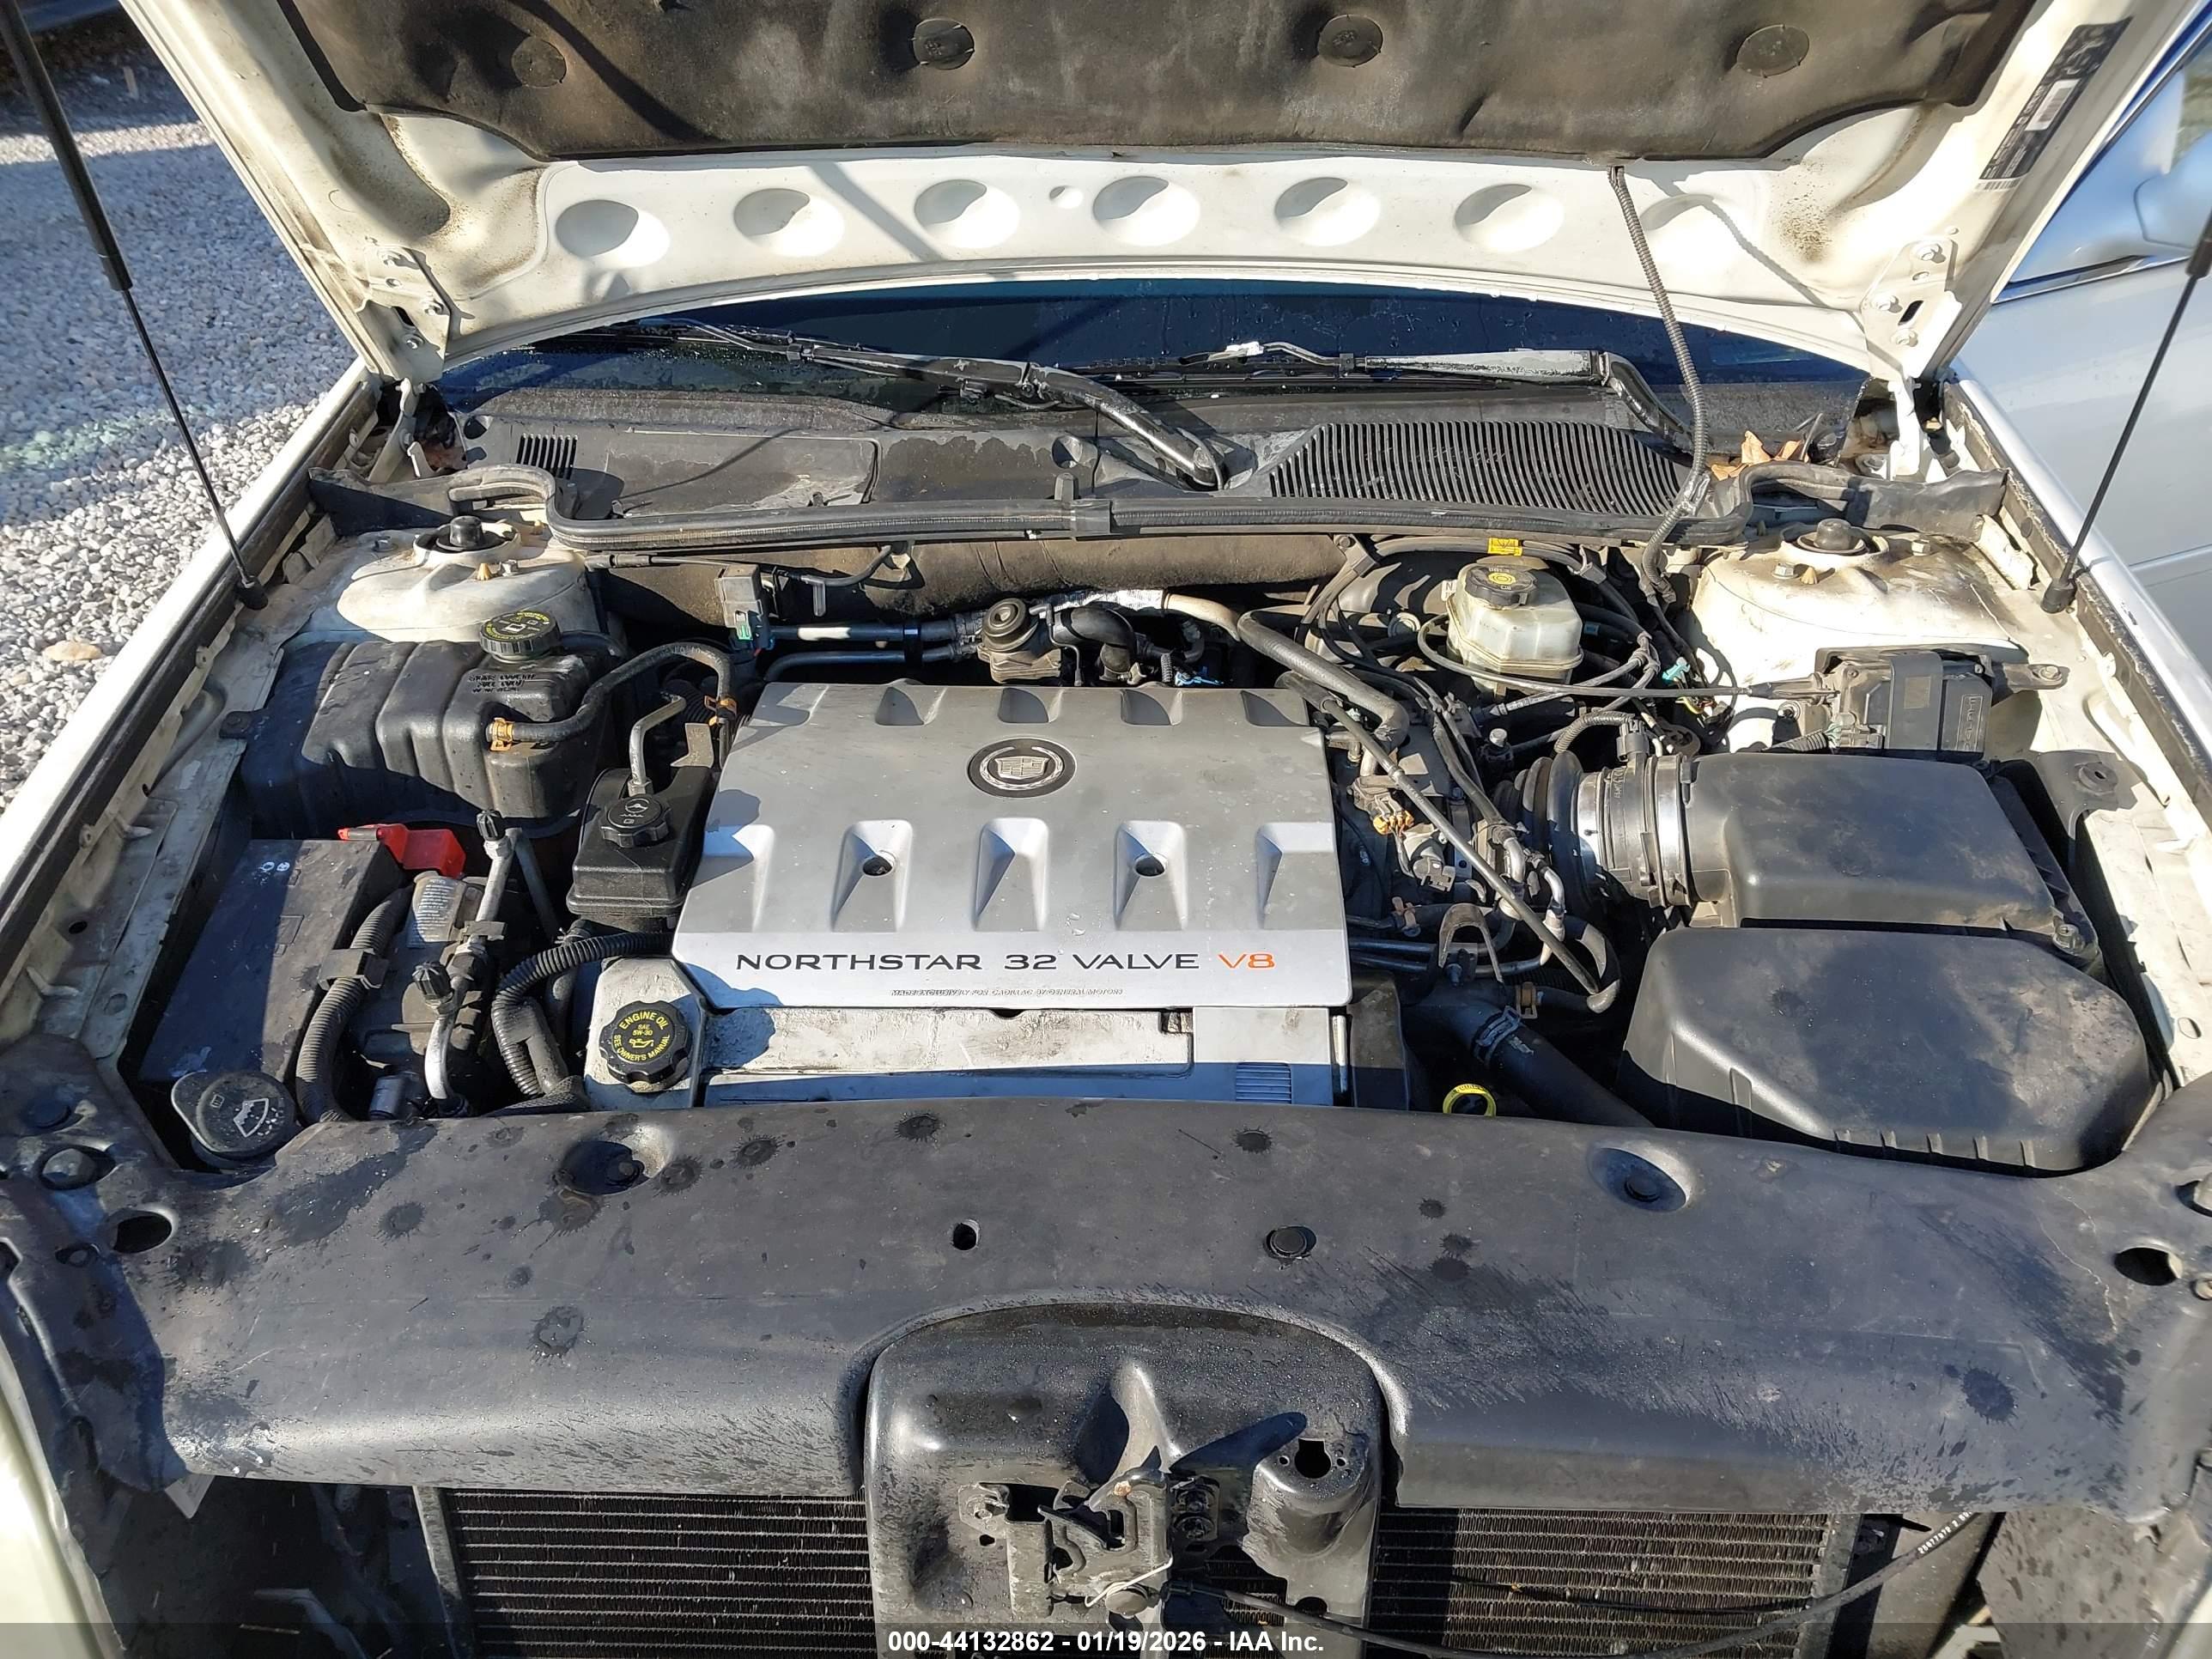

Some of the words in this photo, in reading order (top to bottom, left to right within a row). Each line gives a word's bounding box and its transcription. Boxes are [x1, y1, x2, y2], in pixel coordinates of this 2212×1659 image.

[737, 953, 983, 970] NORTHSTAR
[1004, 954, 1057, 970] 32
[1073, 953, 1200, 969] VALVE
[1218, 953, 1276, 969] V8
[619, 1011, 658, 1030] ENGINE
[655, 1016, 669, 1030] OIL
[613, 1034, 623, 1048] SEE
[647, 1035, 671, 1059] MANUAL
[617, 1047, 647, 1061] OWNER'S
